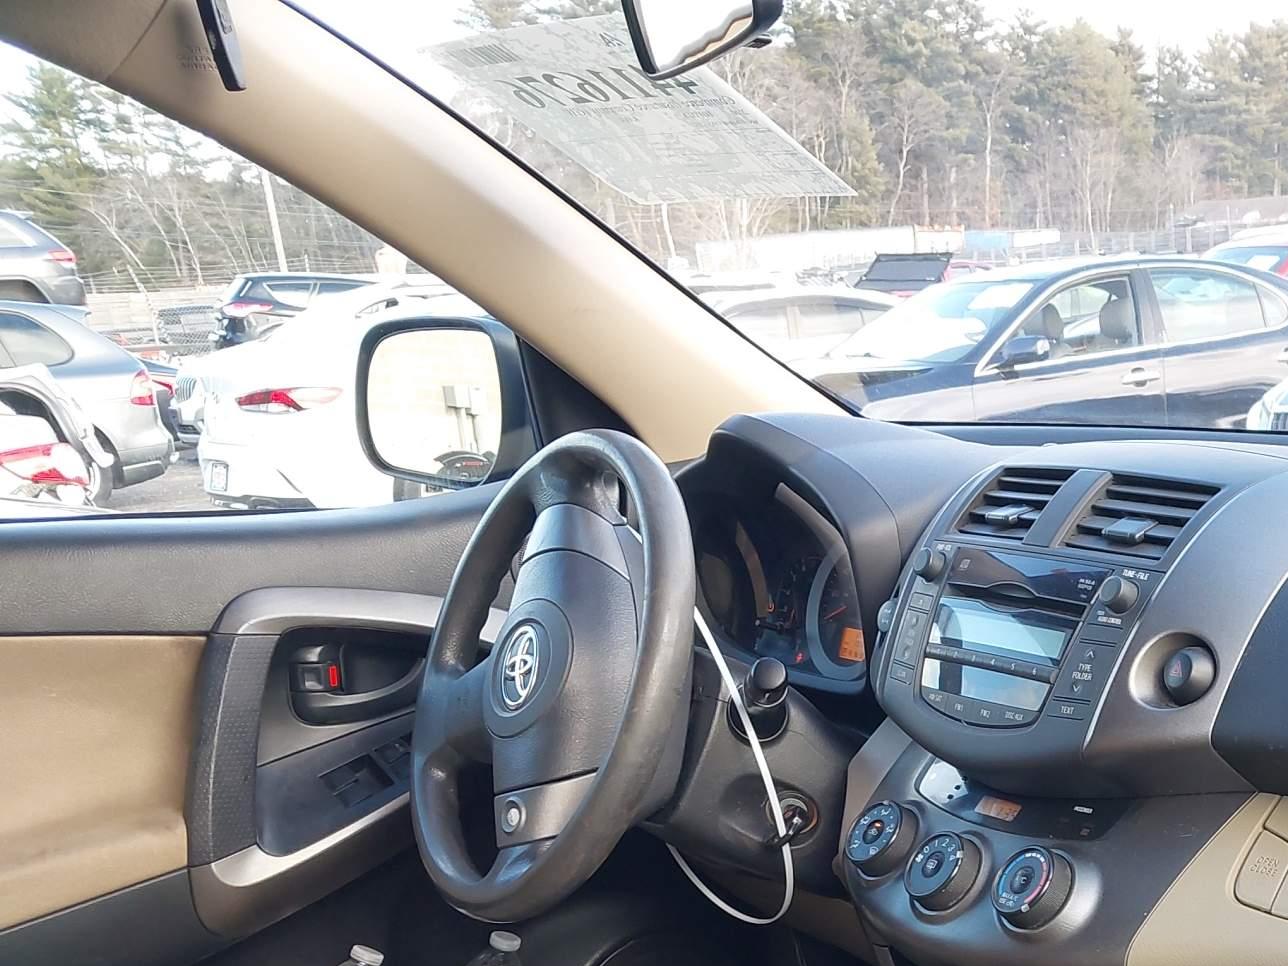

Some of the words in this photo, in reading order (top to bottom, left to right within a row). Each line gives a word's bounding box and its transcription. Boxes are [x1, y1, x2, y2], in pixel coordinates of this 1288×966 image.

[1078, 663, 1093, 672] TYPE
[1072, 671, 1093, 681] FOLDER
[1060, 705, 1075, 715] TEXT
[941, 838, 949, 847] 2
[1256, 856, 1279, 868] OPEN
[1249, 864, 1279, 877] CLOSE
